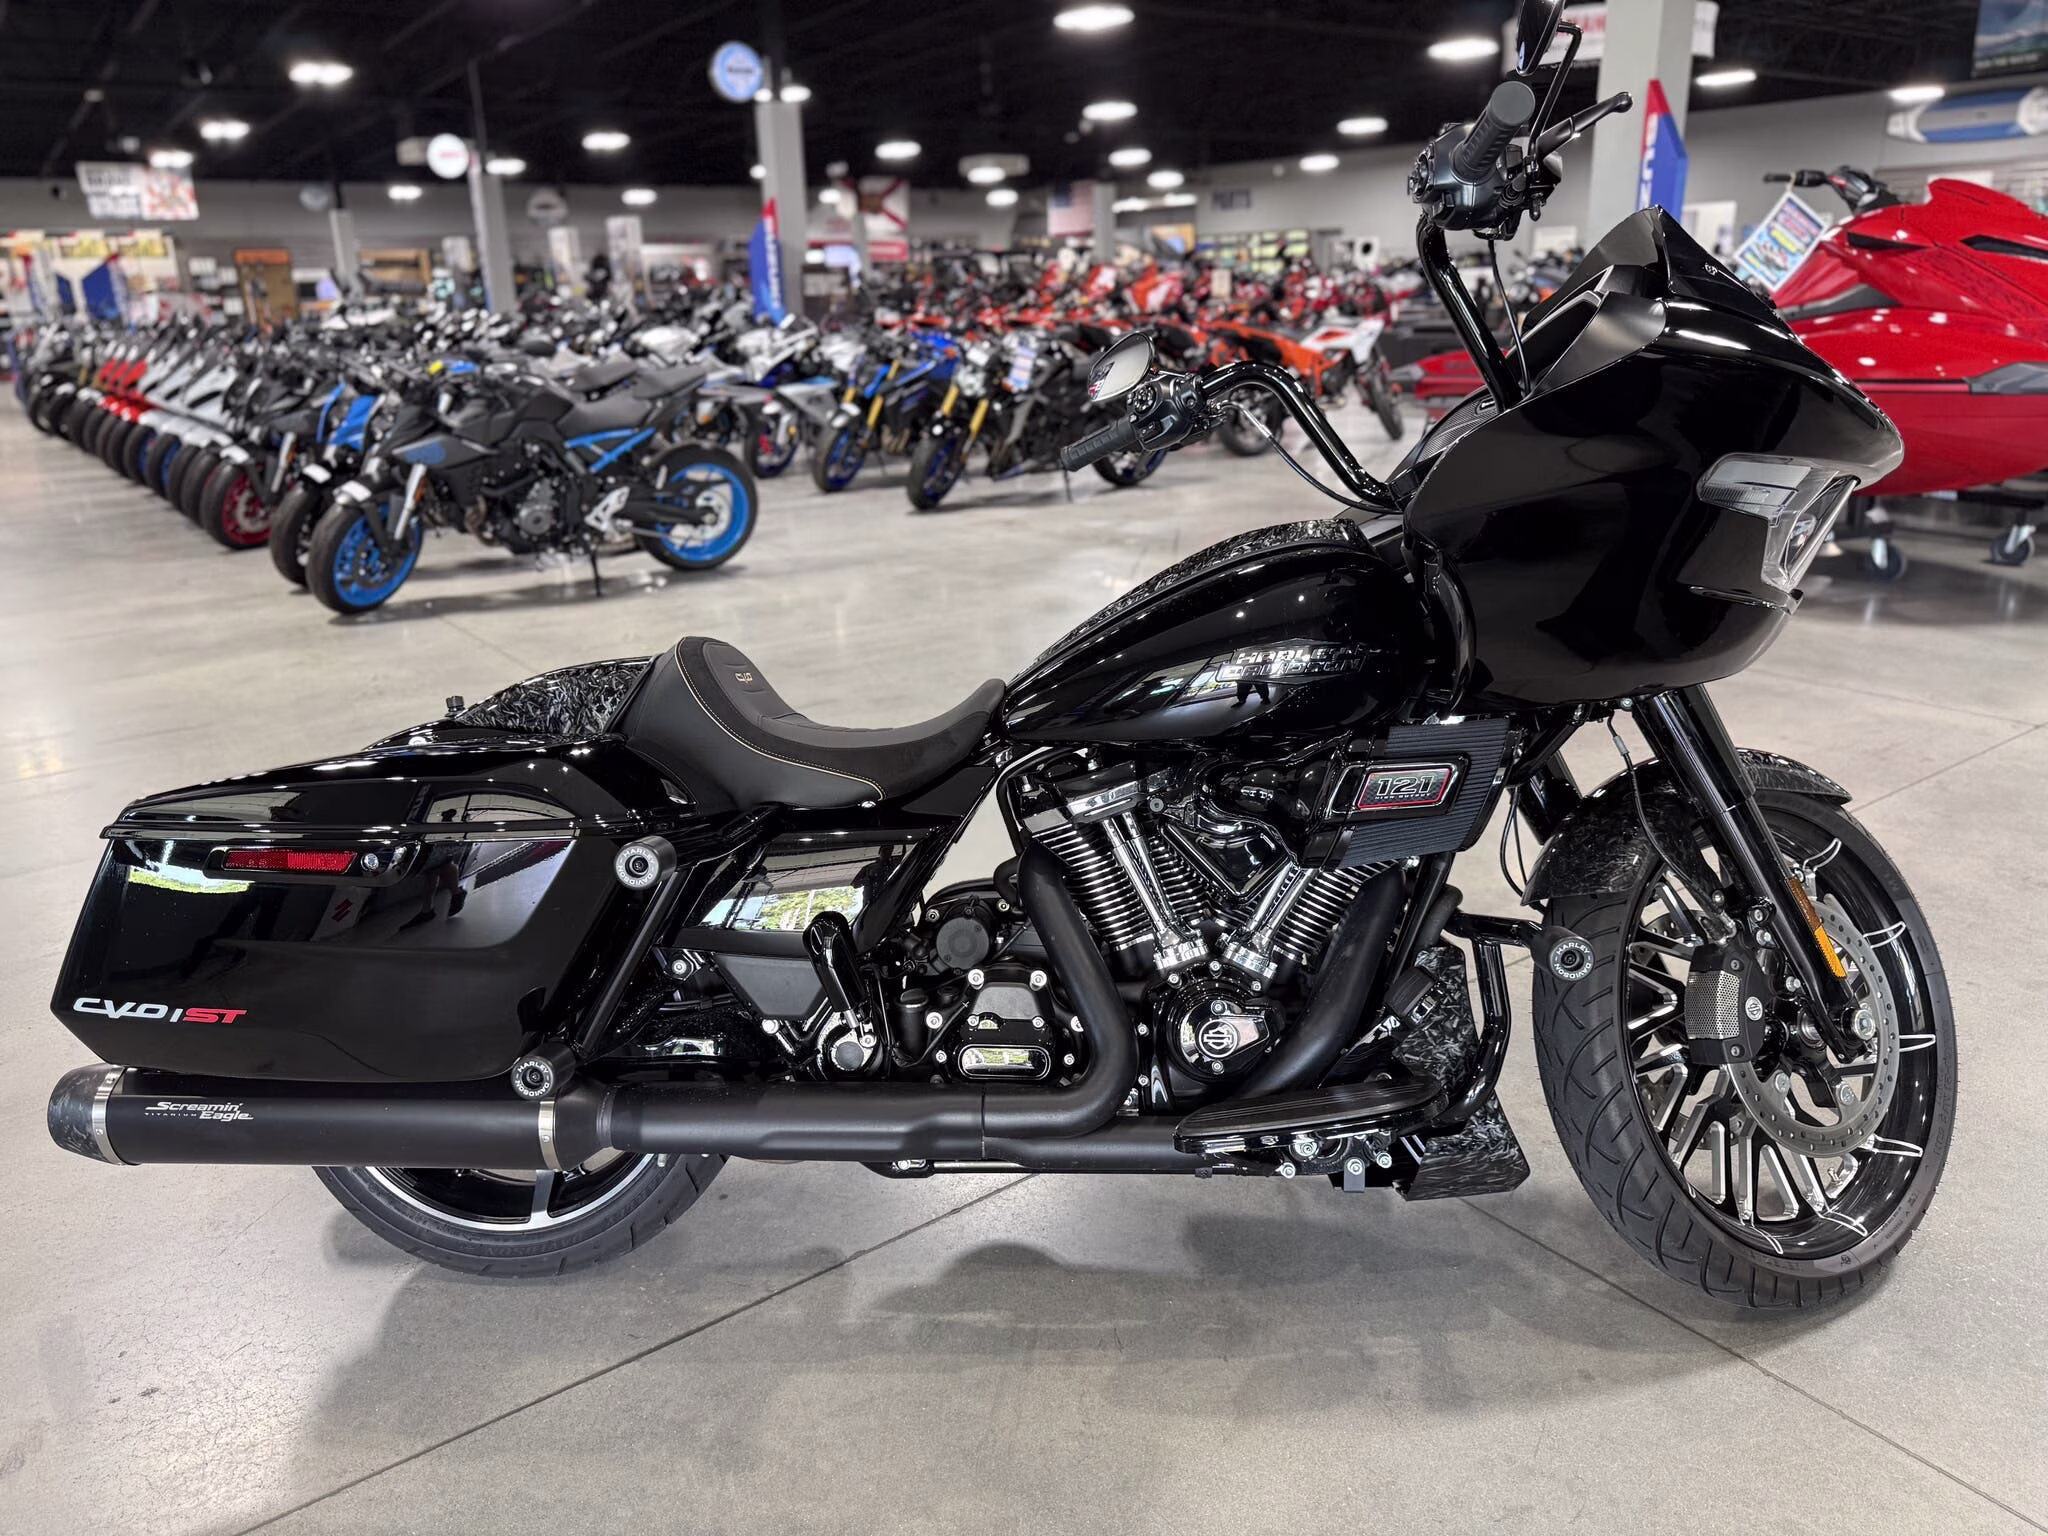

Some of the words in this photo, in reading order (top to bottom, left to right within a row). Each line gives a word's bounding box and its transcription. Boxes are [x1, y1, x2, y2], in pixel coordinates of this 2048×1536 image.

[1376, 775, 1435, 796] 121
[623, 847, 656, 864] HARLEY
[616, 865, 653, 885] DAVIDSON
[1556, 942, 1590, 955] HARLEY
[1554, 963, 1591, 979] DAVIDSON
[517, 1061, 549, 1073] HARLEY
[515, 1080, 550, 1097] DAVIDSON
[199, 1111, 254, 1122] Eagle
